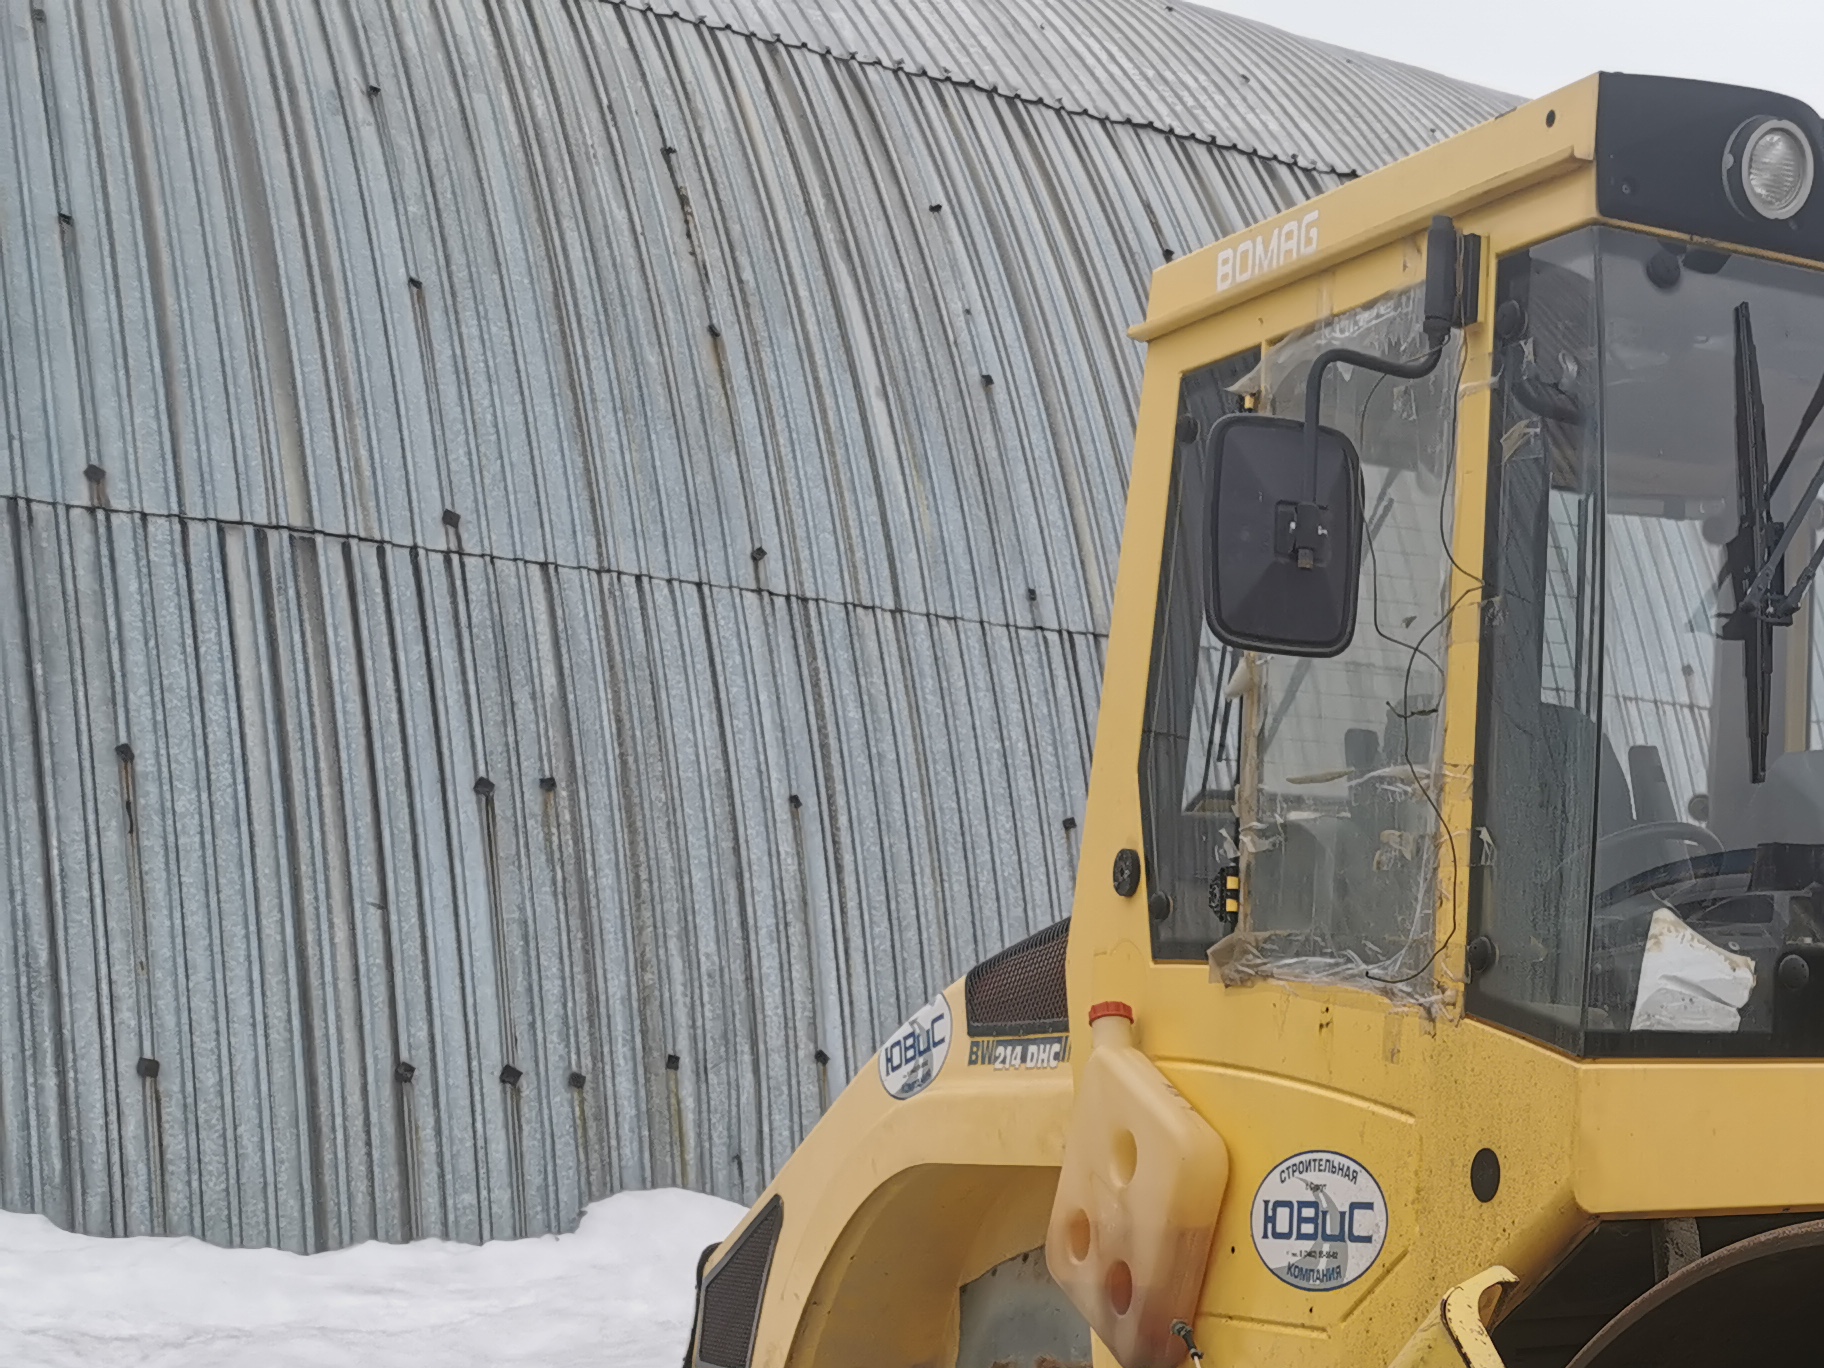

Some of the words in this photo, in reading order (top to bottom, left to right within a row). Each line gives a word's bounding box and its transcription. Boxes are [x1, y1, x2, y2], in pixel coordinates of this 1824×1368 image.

[1216, 210, 1319, 292] BOMAG
[994, 1045, 1022, 1071] 214
[1025, 1043, 1062, 1070] DHC
[1279, 1158, 1359, 1185] СТРОИТЕЛЬНАЯ
[1286, 1261, 1342, 1283] КОМПАНИЯ
